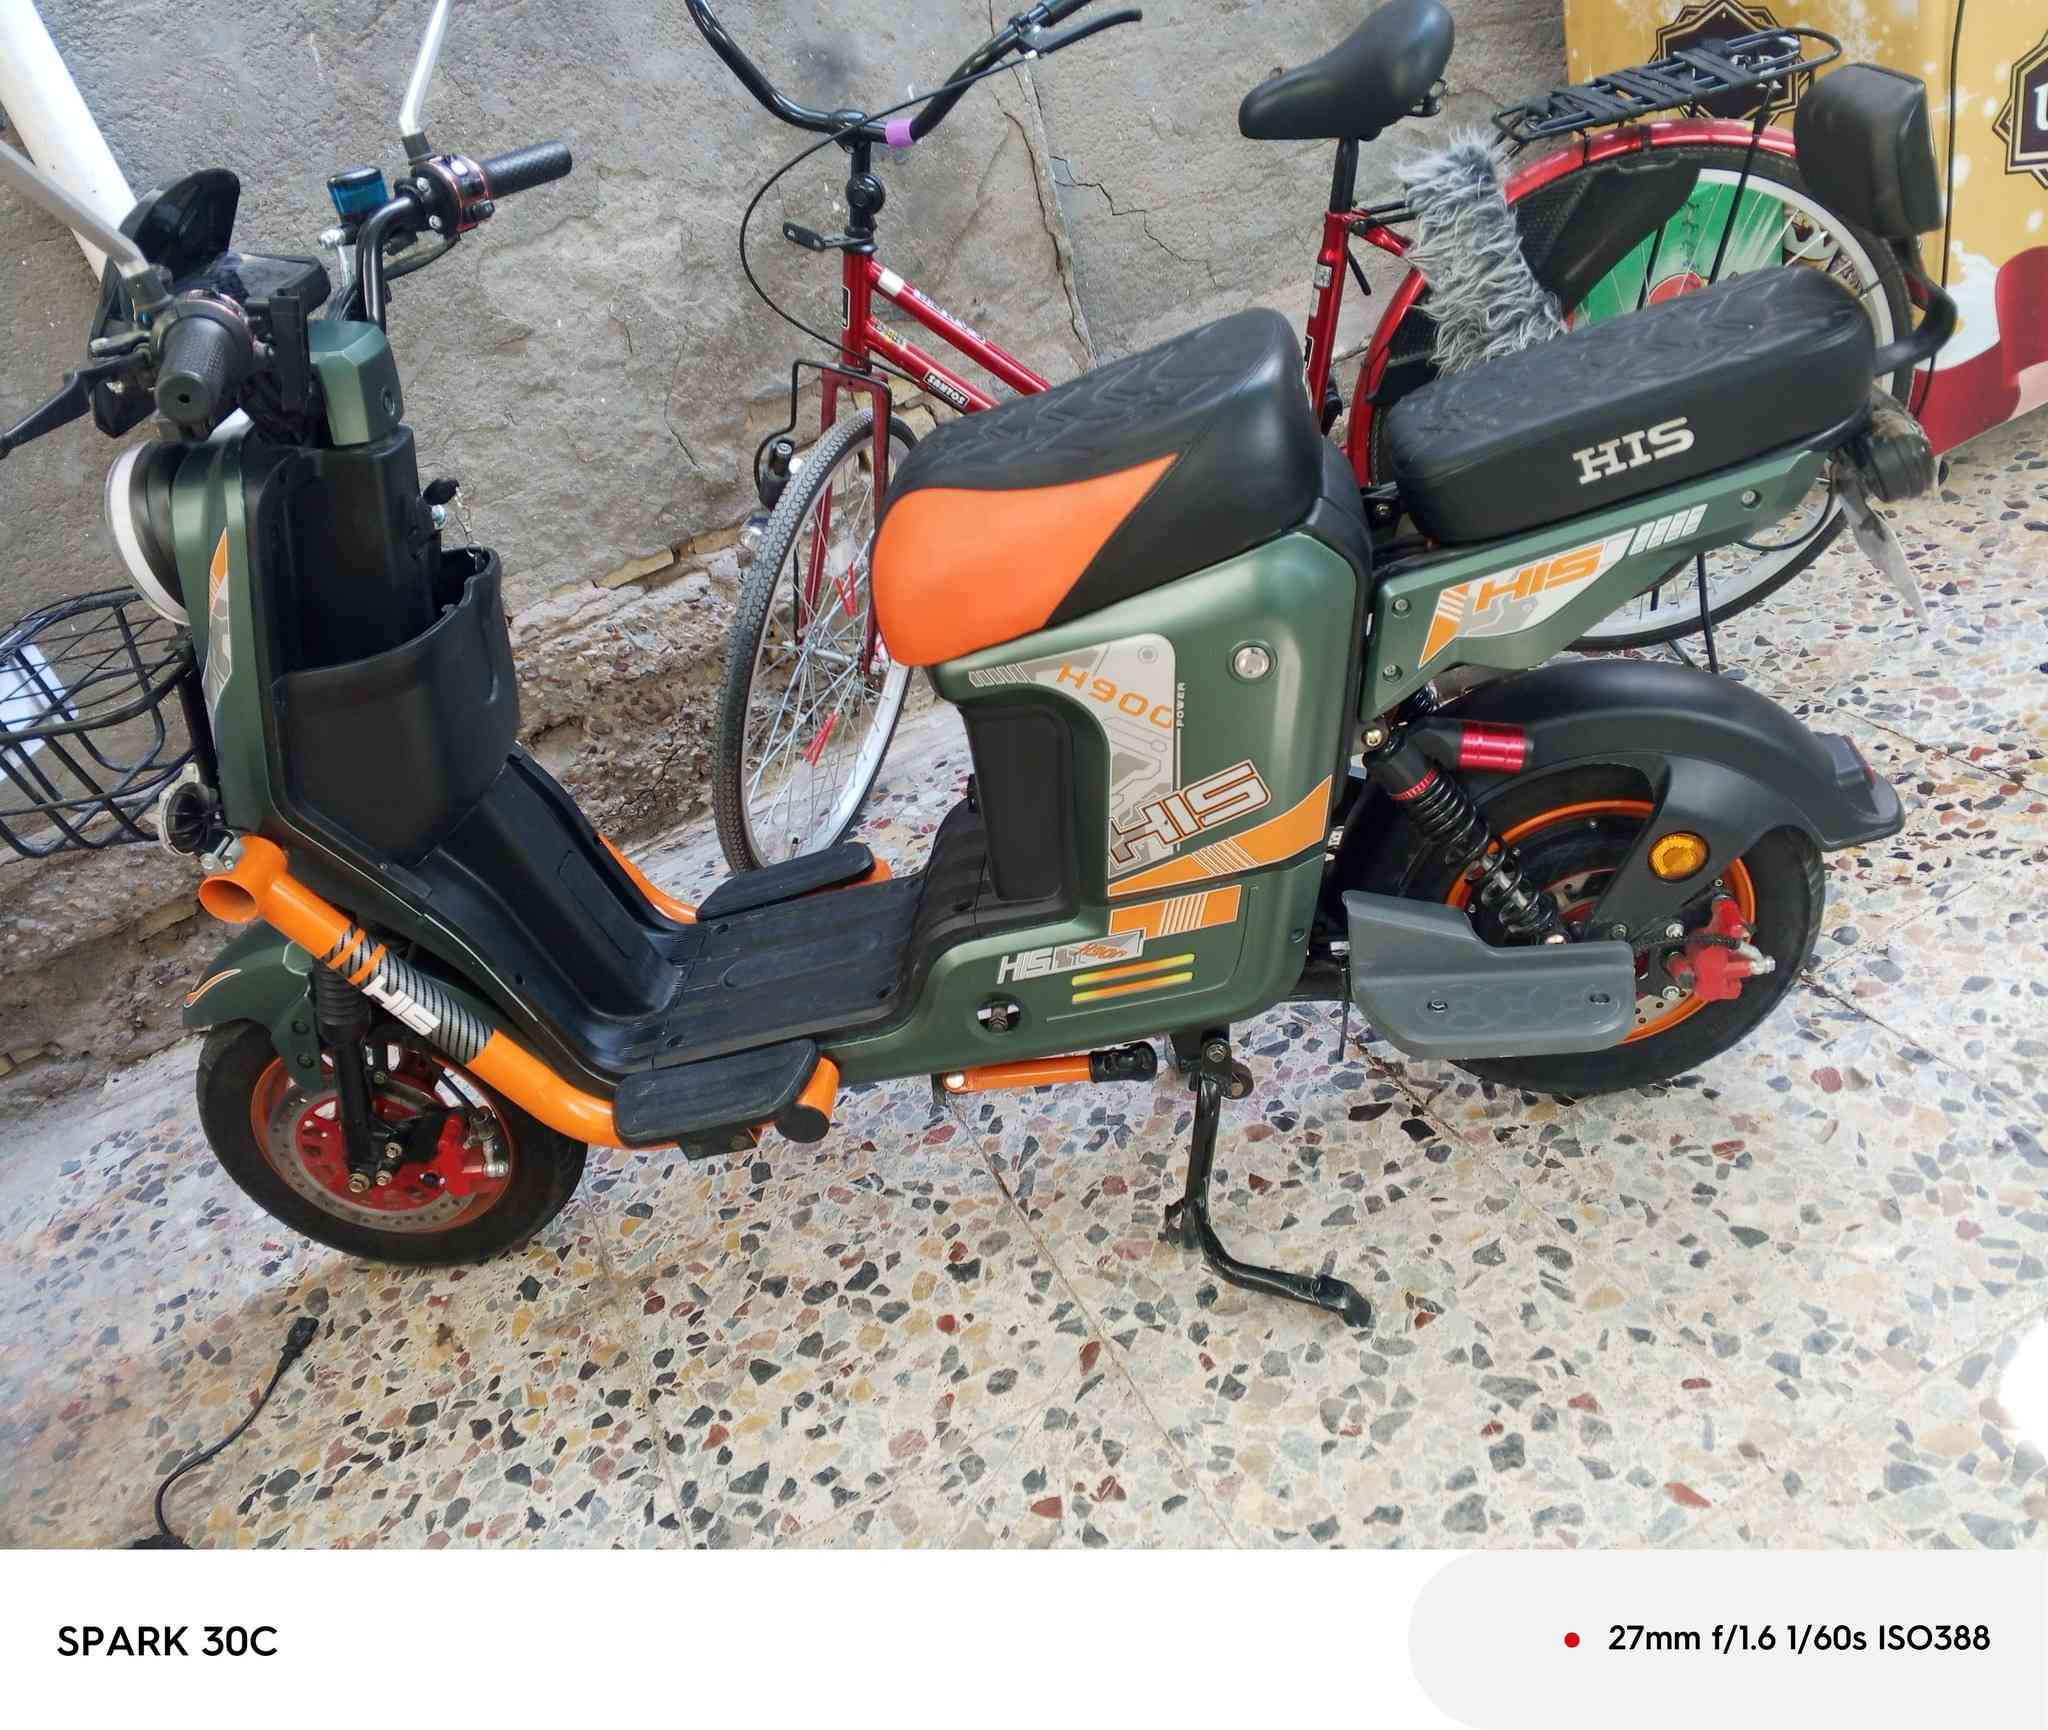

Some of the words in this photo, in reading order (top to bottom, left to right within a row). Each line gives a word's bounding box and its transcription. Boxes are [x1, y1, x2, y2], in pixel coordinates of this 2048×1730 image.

[1572, 416, 1696, 485] HIS
[1472, 542, 1606, 615] HIS
[1176, 682, 1186, 728] POWER
[1111, 759, 1271, 866] HIS
[361, 974, 442, 1036] HIS
